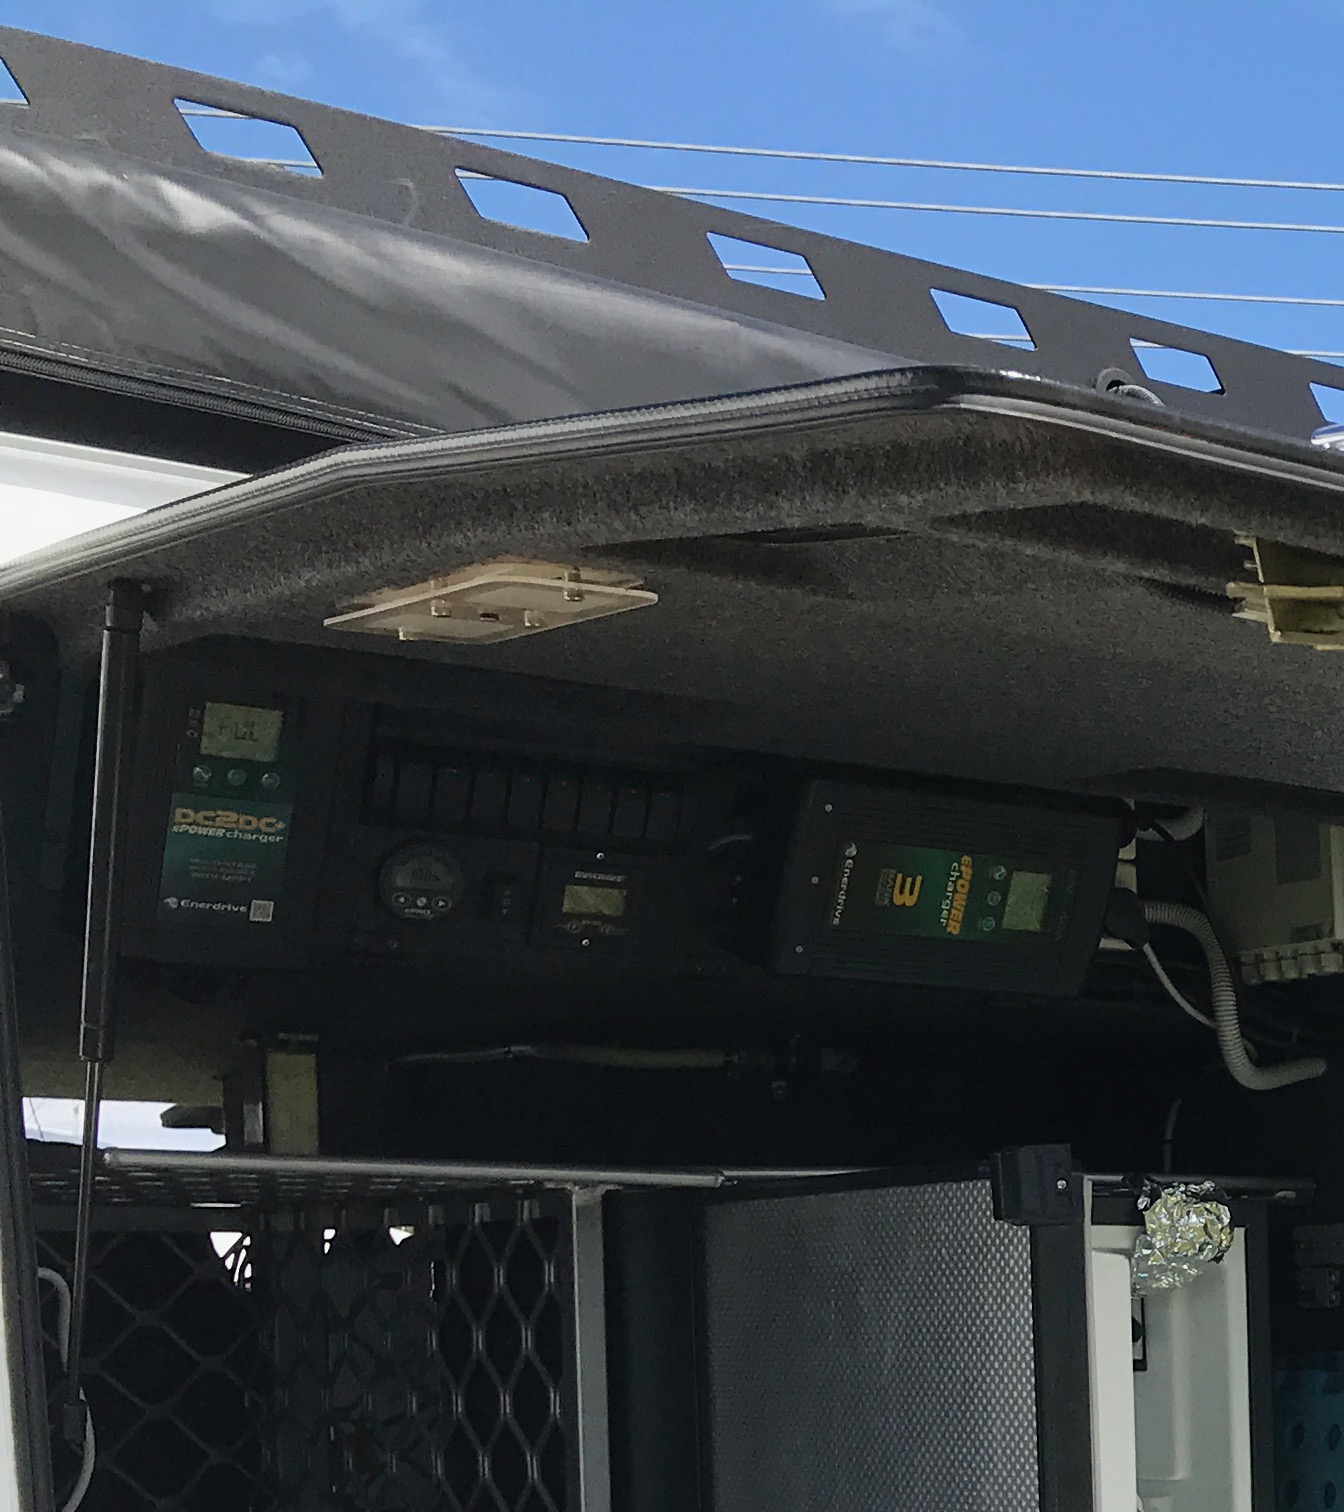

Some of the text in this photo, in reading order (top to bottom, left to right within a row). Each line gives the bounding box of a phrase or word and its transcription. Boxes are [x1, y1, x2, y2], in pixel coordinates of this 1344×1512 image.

[226, 830, 284, 844] charger
[891, 871, 924, 907] 3
[939, 861, 961, 927] charger
